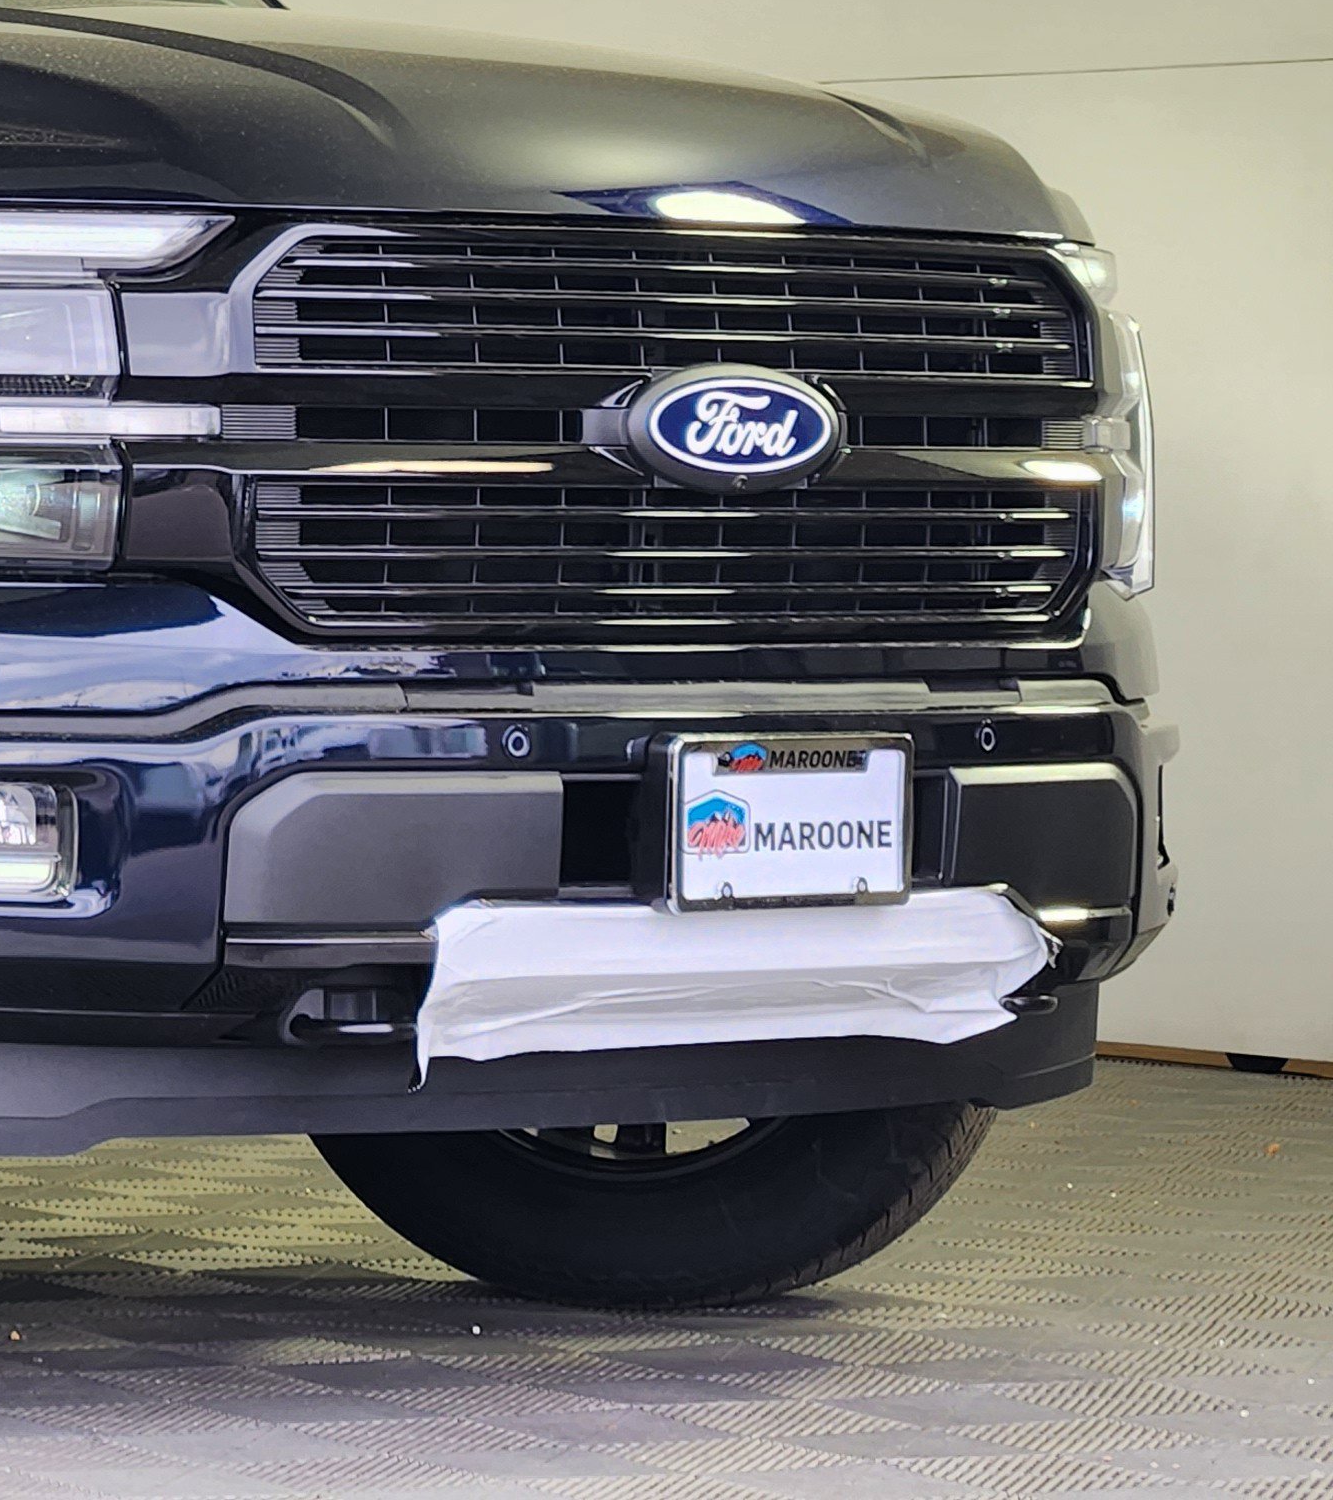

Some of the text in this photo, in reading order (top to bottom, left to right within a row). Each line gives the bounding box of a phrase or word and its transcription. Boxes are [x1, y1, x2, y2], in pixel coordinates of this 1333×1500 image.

[685, 391, 798, 457] Ford
[768, 750, 857, 769] MAROONE
[753, 819, 893, 852] MAROONE
